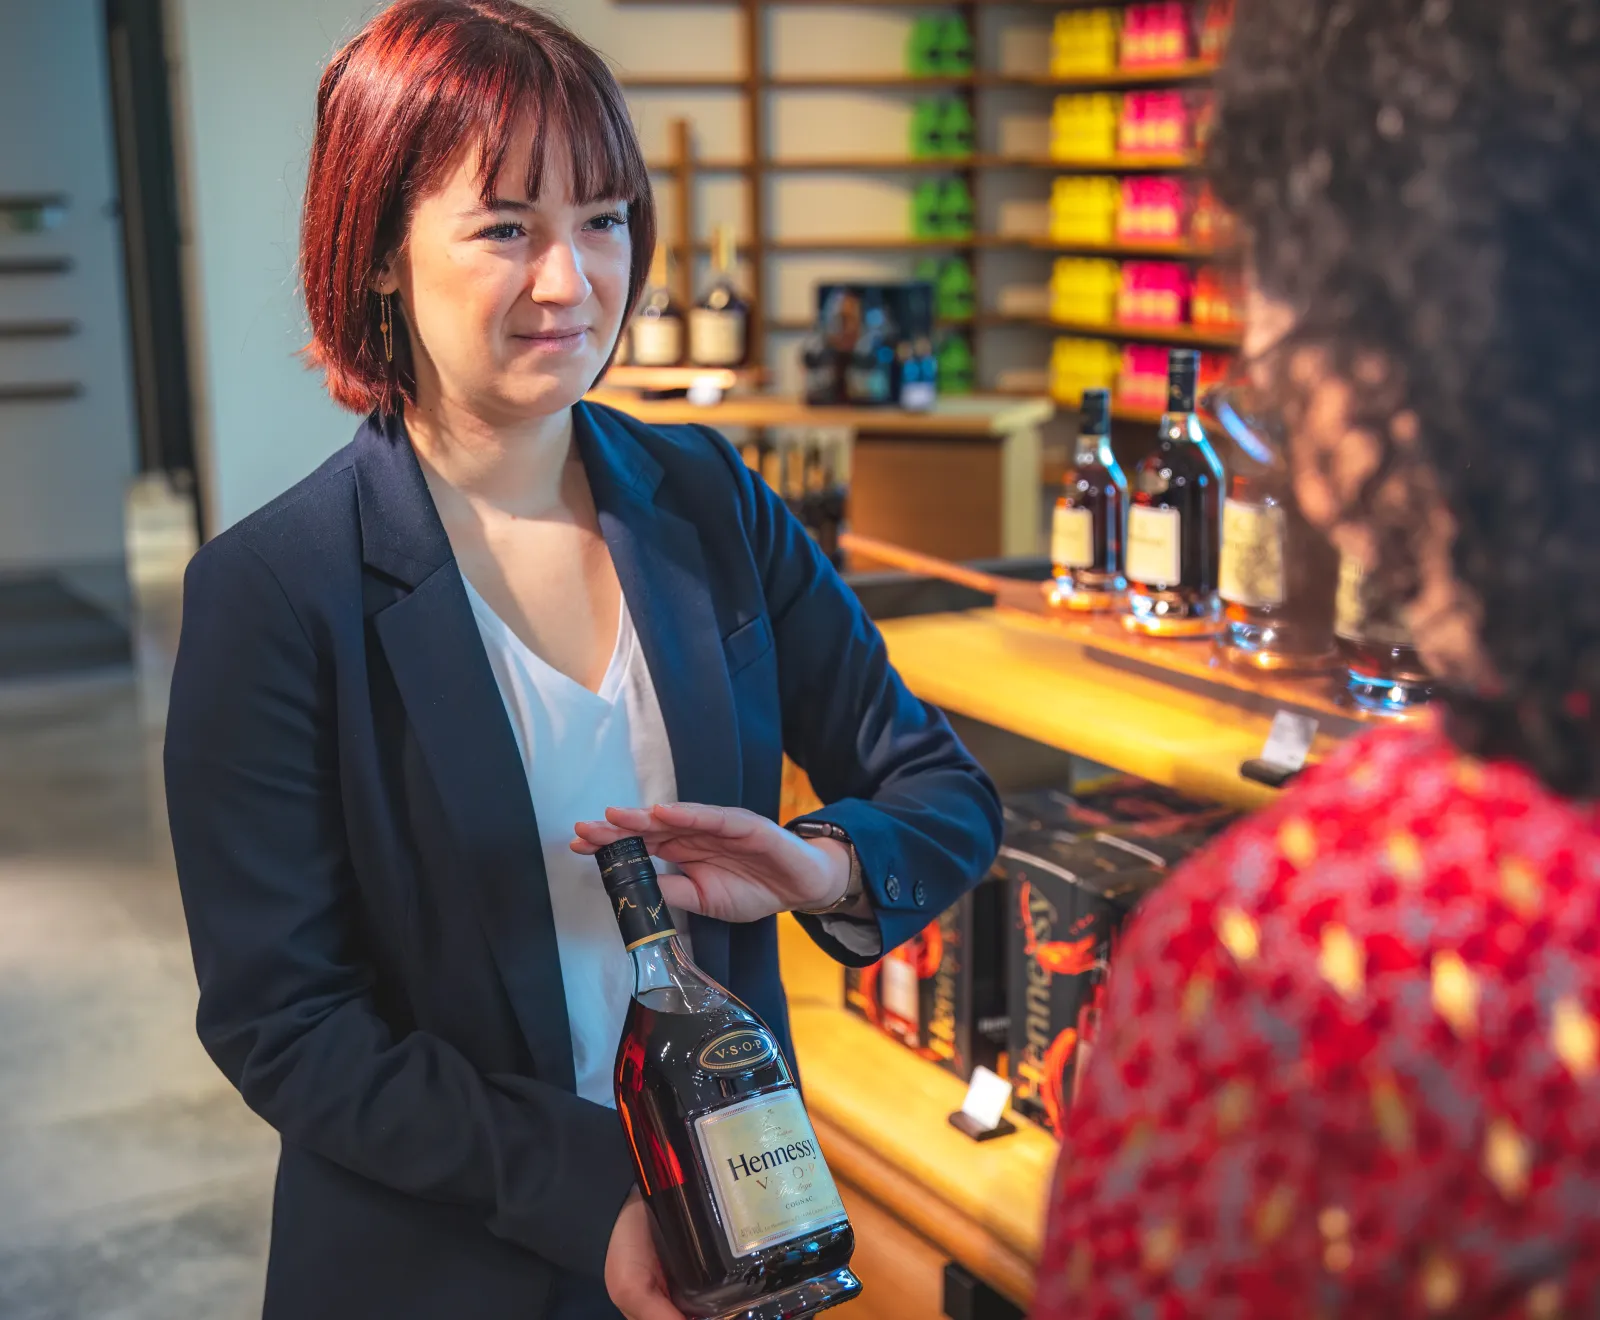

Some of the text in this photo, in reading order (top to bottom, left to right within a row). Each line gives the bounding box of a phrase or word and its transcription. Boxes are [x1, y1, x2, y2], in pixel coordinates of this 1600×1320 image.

[1016, 881, 1059, 1105] Hennesy
[725, 1138, 818, 1182] Hennessy
[785, 1195, 814, 1211] COGNAC
